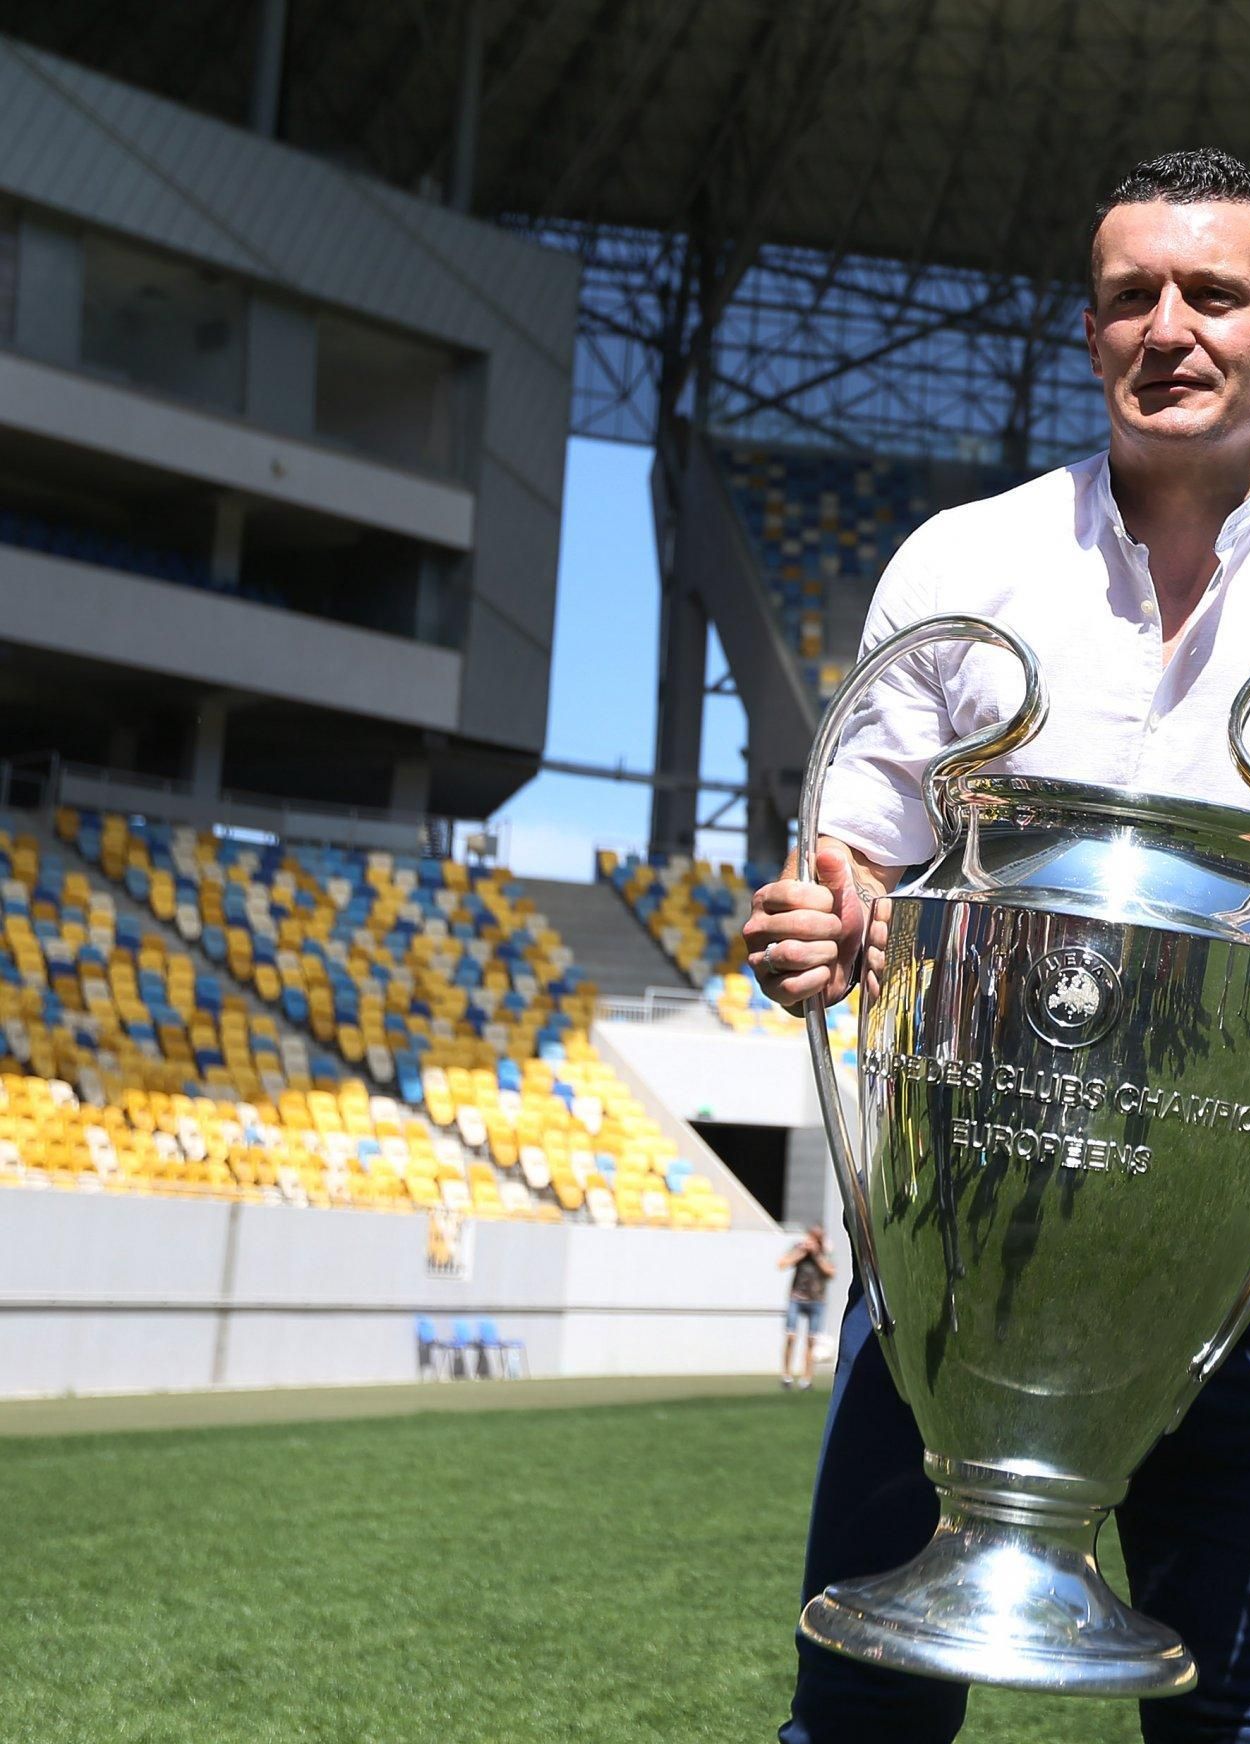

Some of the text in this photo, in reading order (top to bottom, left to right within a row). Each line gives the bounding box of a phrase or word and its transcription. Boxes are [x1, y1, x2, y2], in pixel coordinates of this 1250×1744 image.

[1044, 951, 1106, 979] UEFA
[925, 1057, 983, 1091] DES
[990, 1063, 1107, 1111] CLUBS
